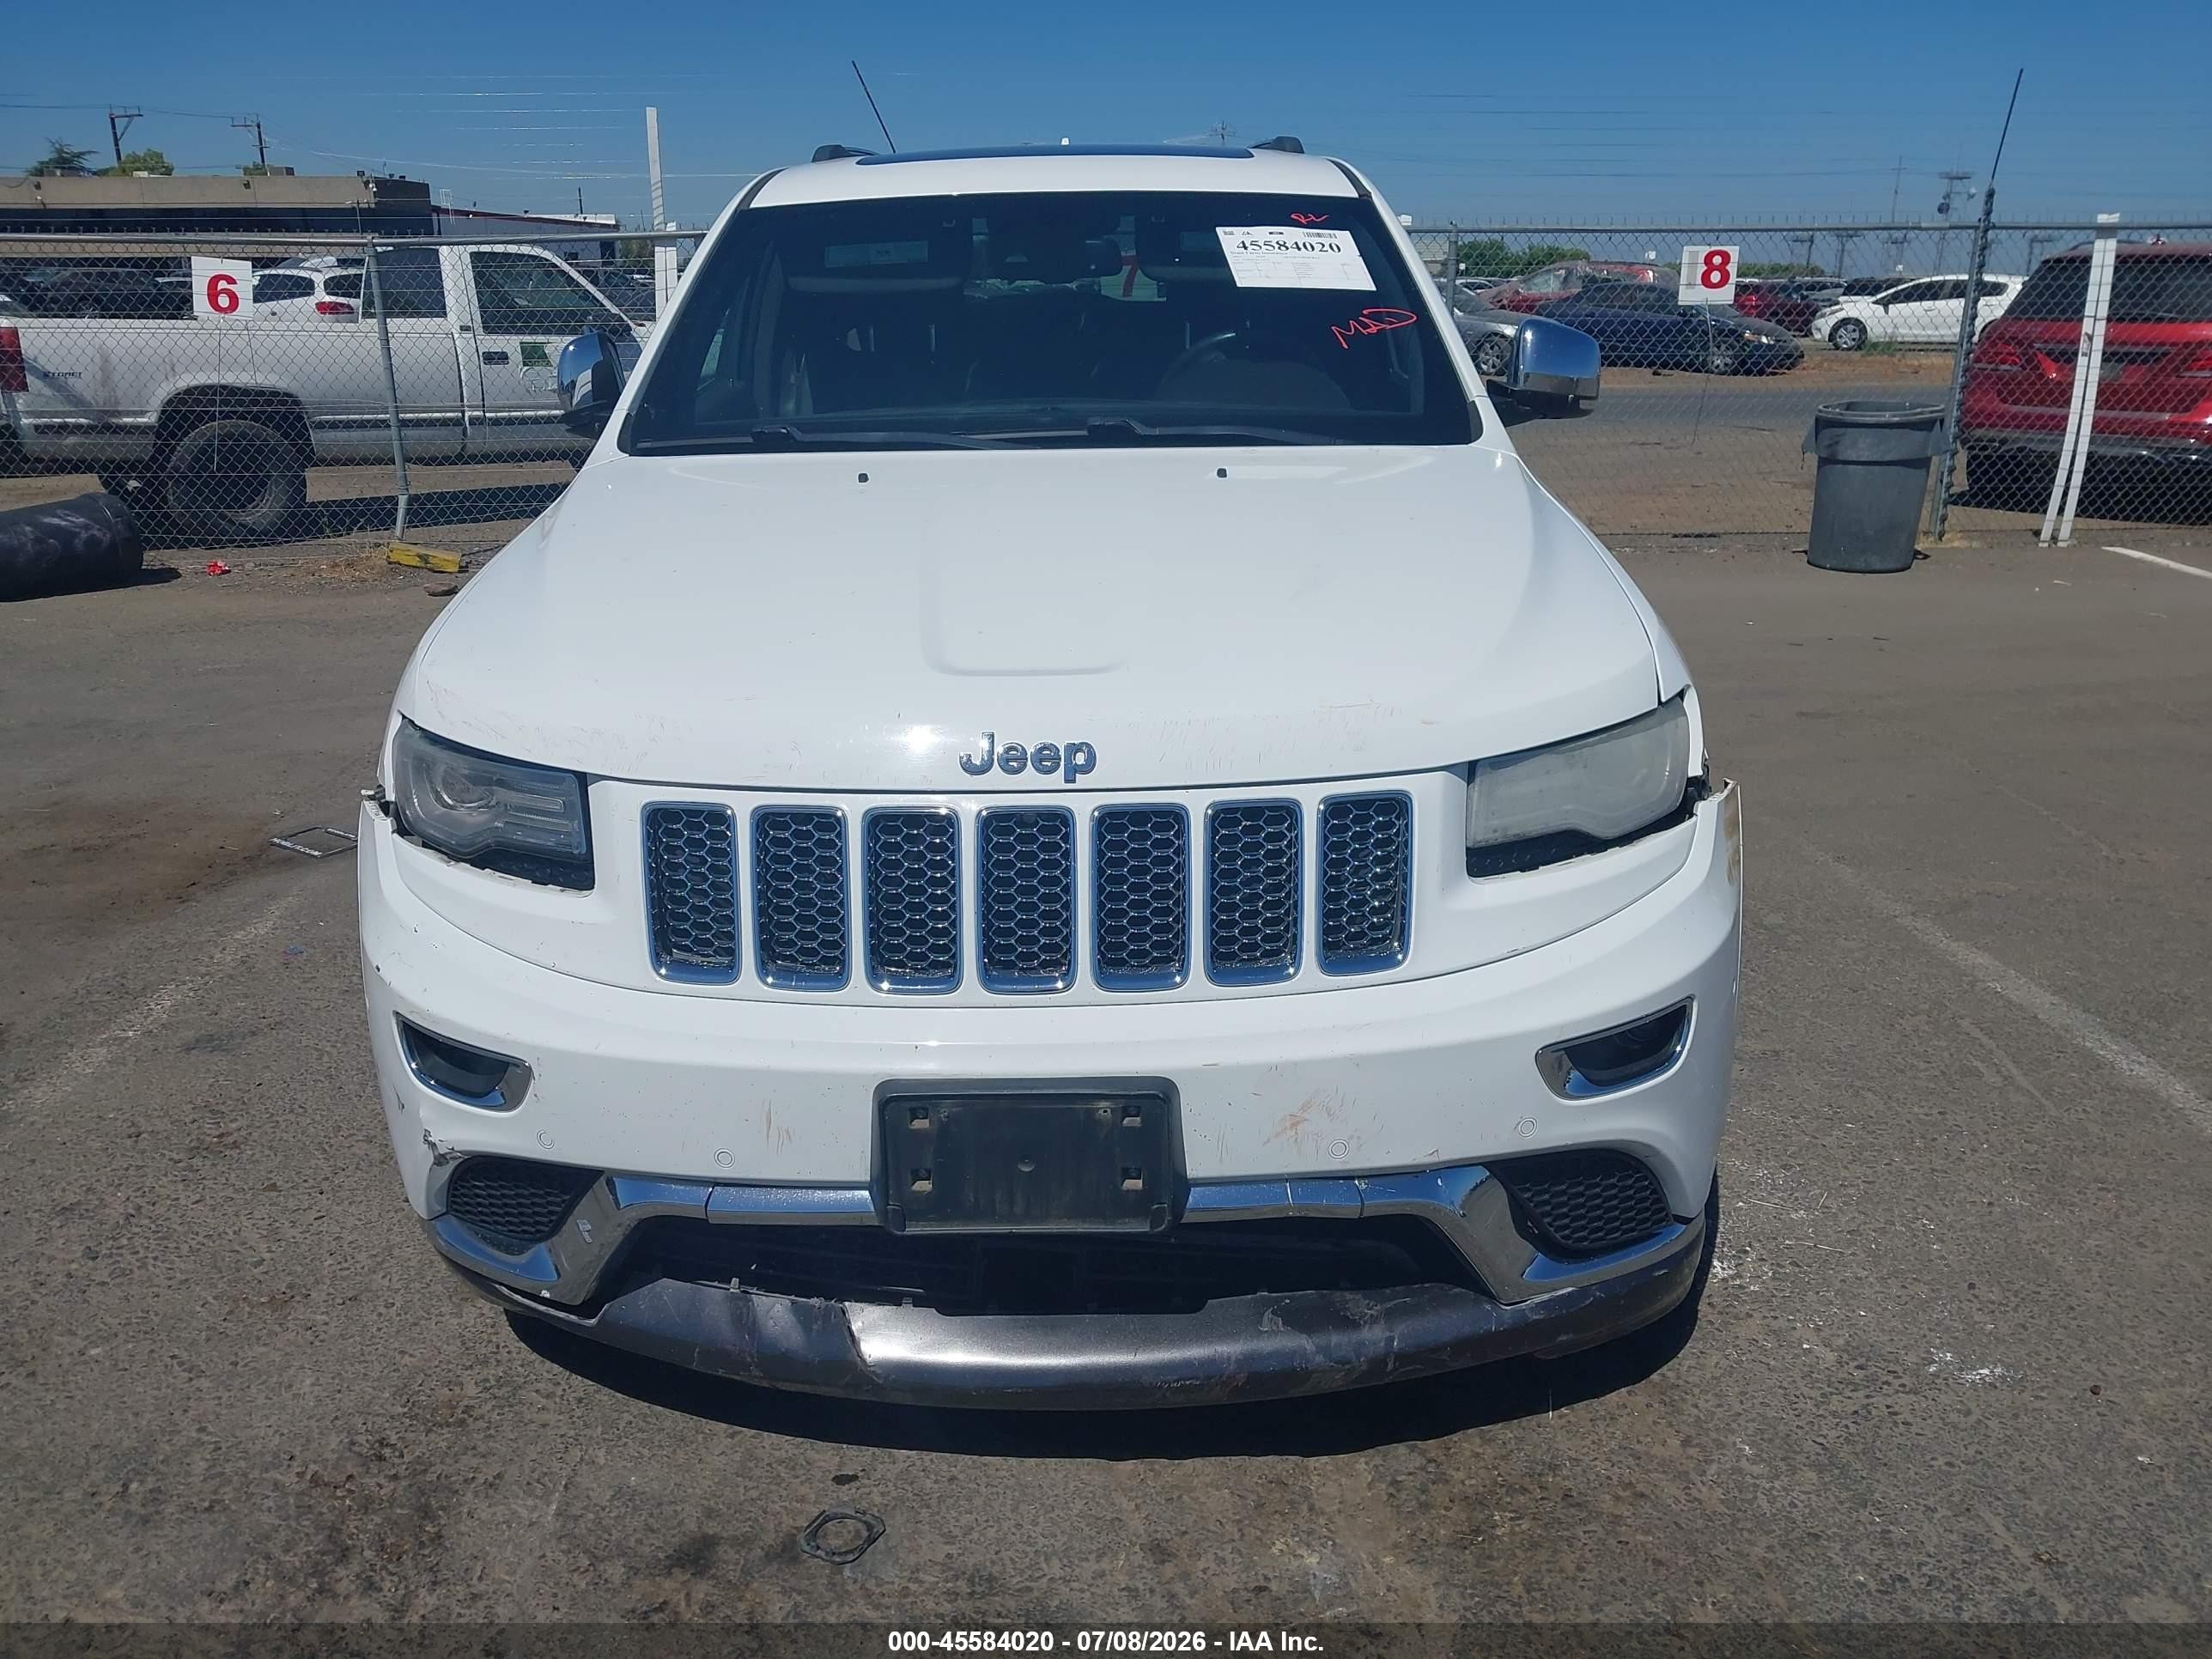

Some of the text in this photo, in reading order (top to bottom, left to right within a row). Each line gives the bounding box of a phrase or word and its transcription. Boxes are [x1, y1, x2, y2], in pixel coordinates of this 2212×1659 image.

[1237, 240, 1341, 253] 45584020
[1701, 249, 1731, 289] 8
[207, 274, 239, 314] 6
[959, 731, 1097, 783] Jeep
